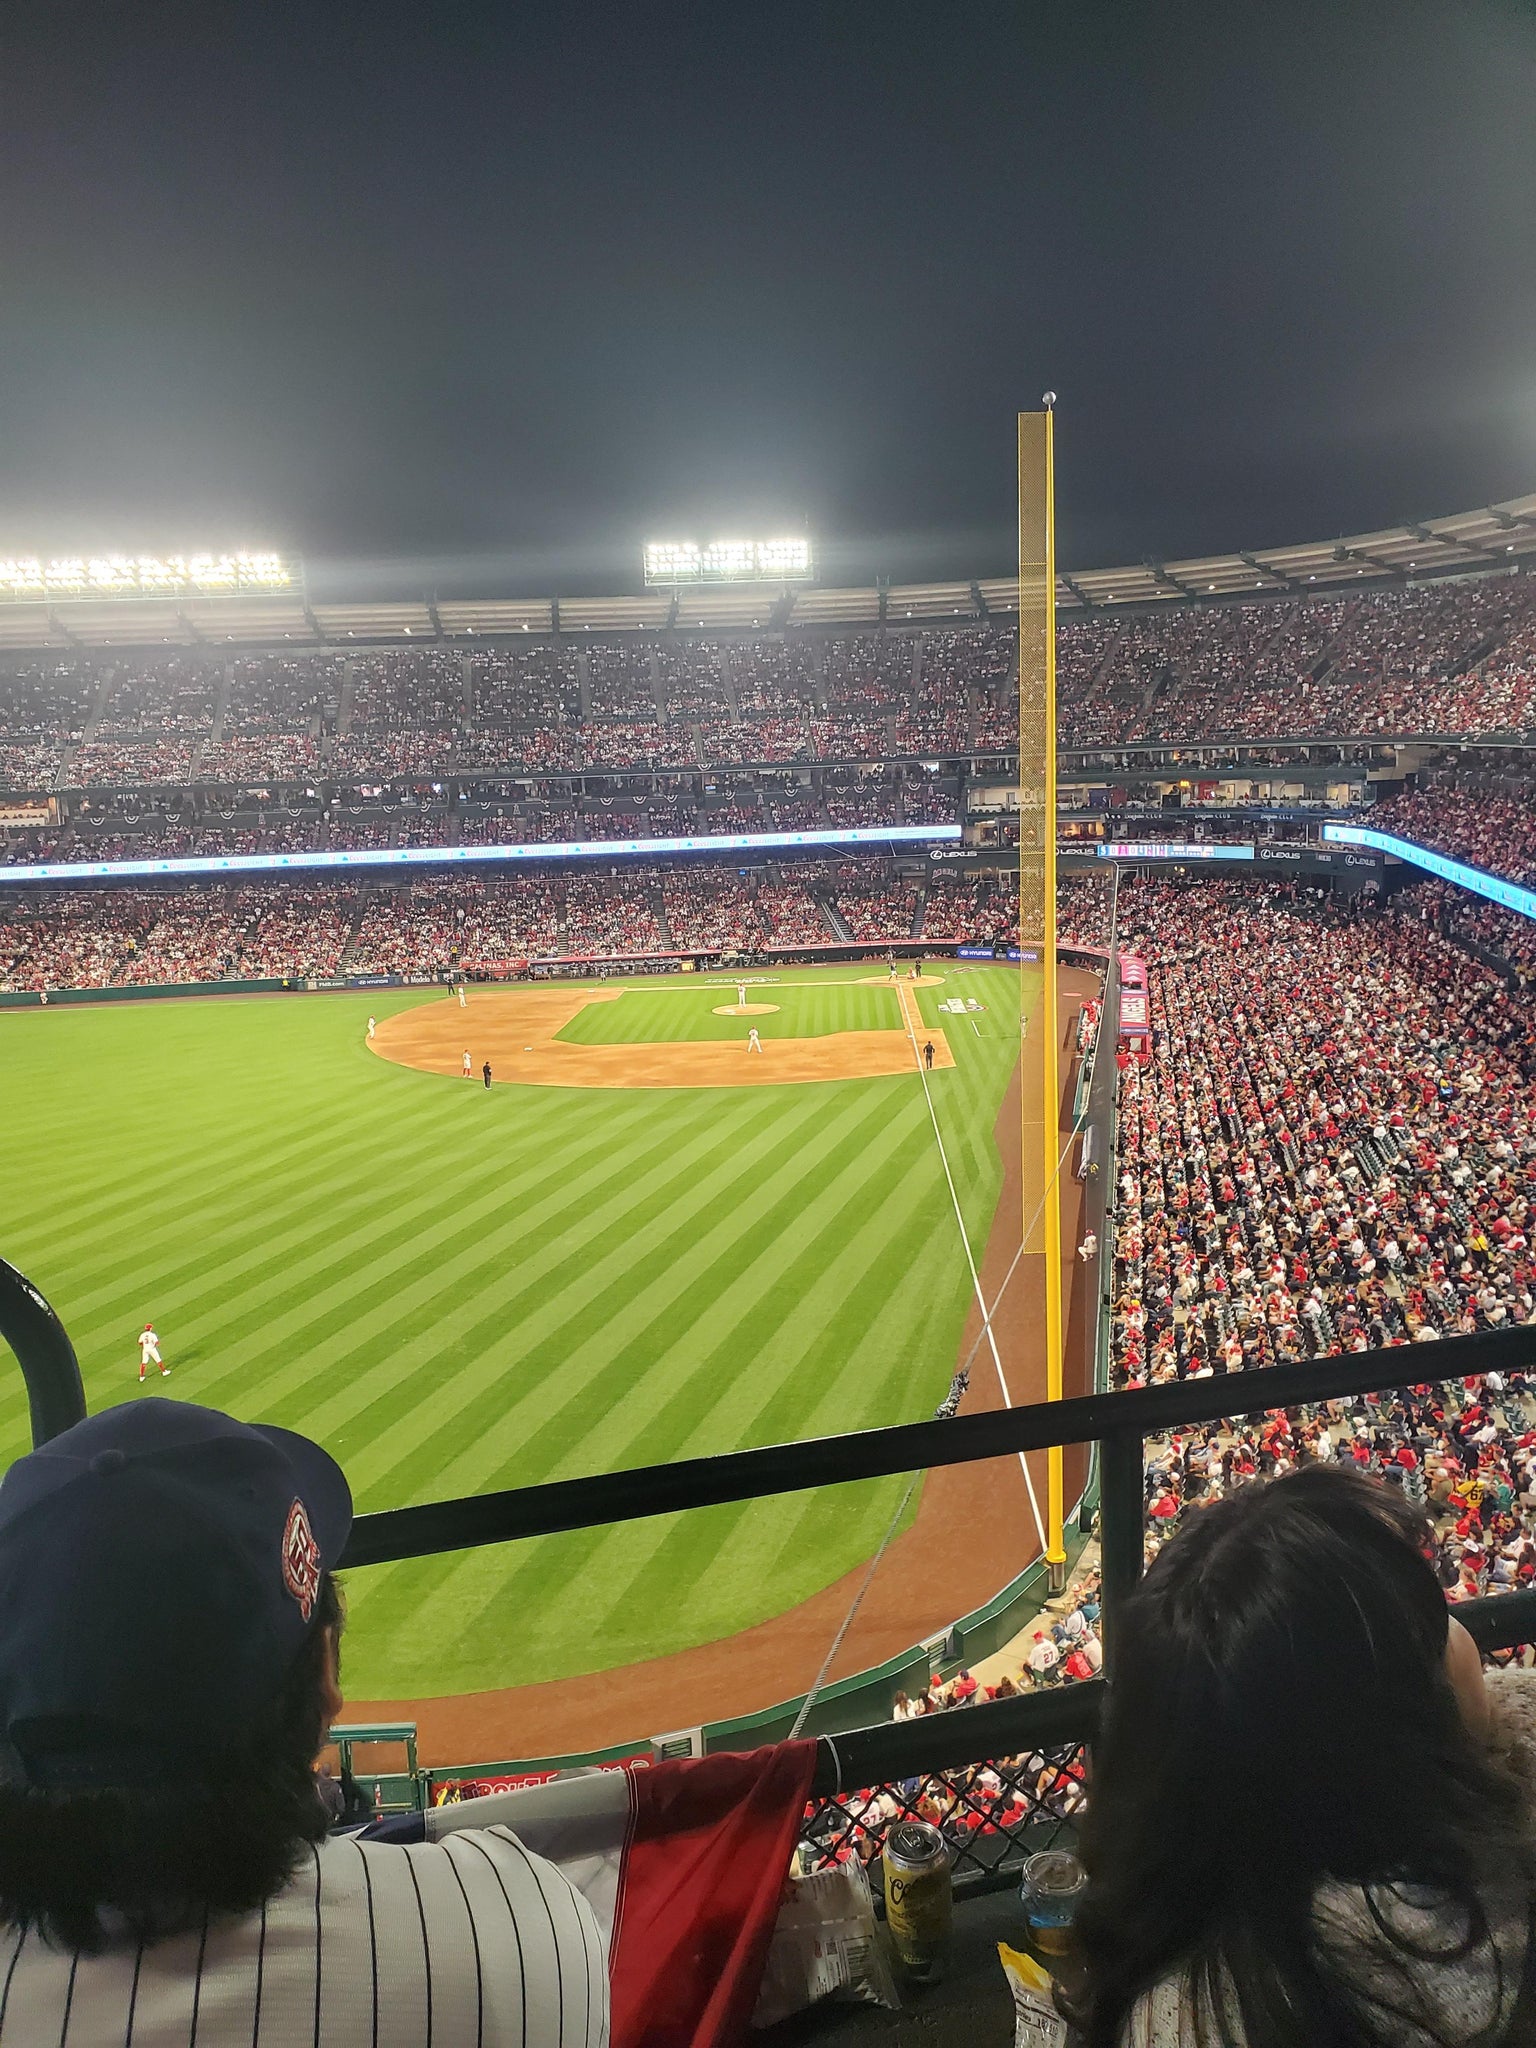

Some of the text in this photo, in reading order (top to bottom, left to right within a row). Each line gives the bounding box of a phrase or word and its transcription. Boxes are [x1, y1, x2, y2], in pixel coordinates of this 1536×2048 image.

[1271, 851, 1300, 859] LEXUS
[1354, 857, 1376, 867] LEXUS
[410, 975, 431, 984] Modelo
[1121, 997, 1146, 1024] ANGELS
[1043, 1651, 1054, 1665] 27
